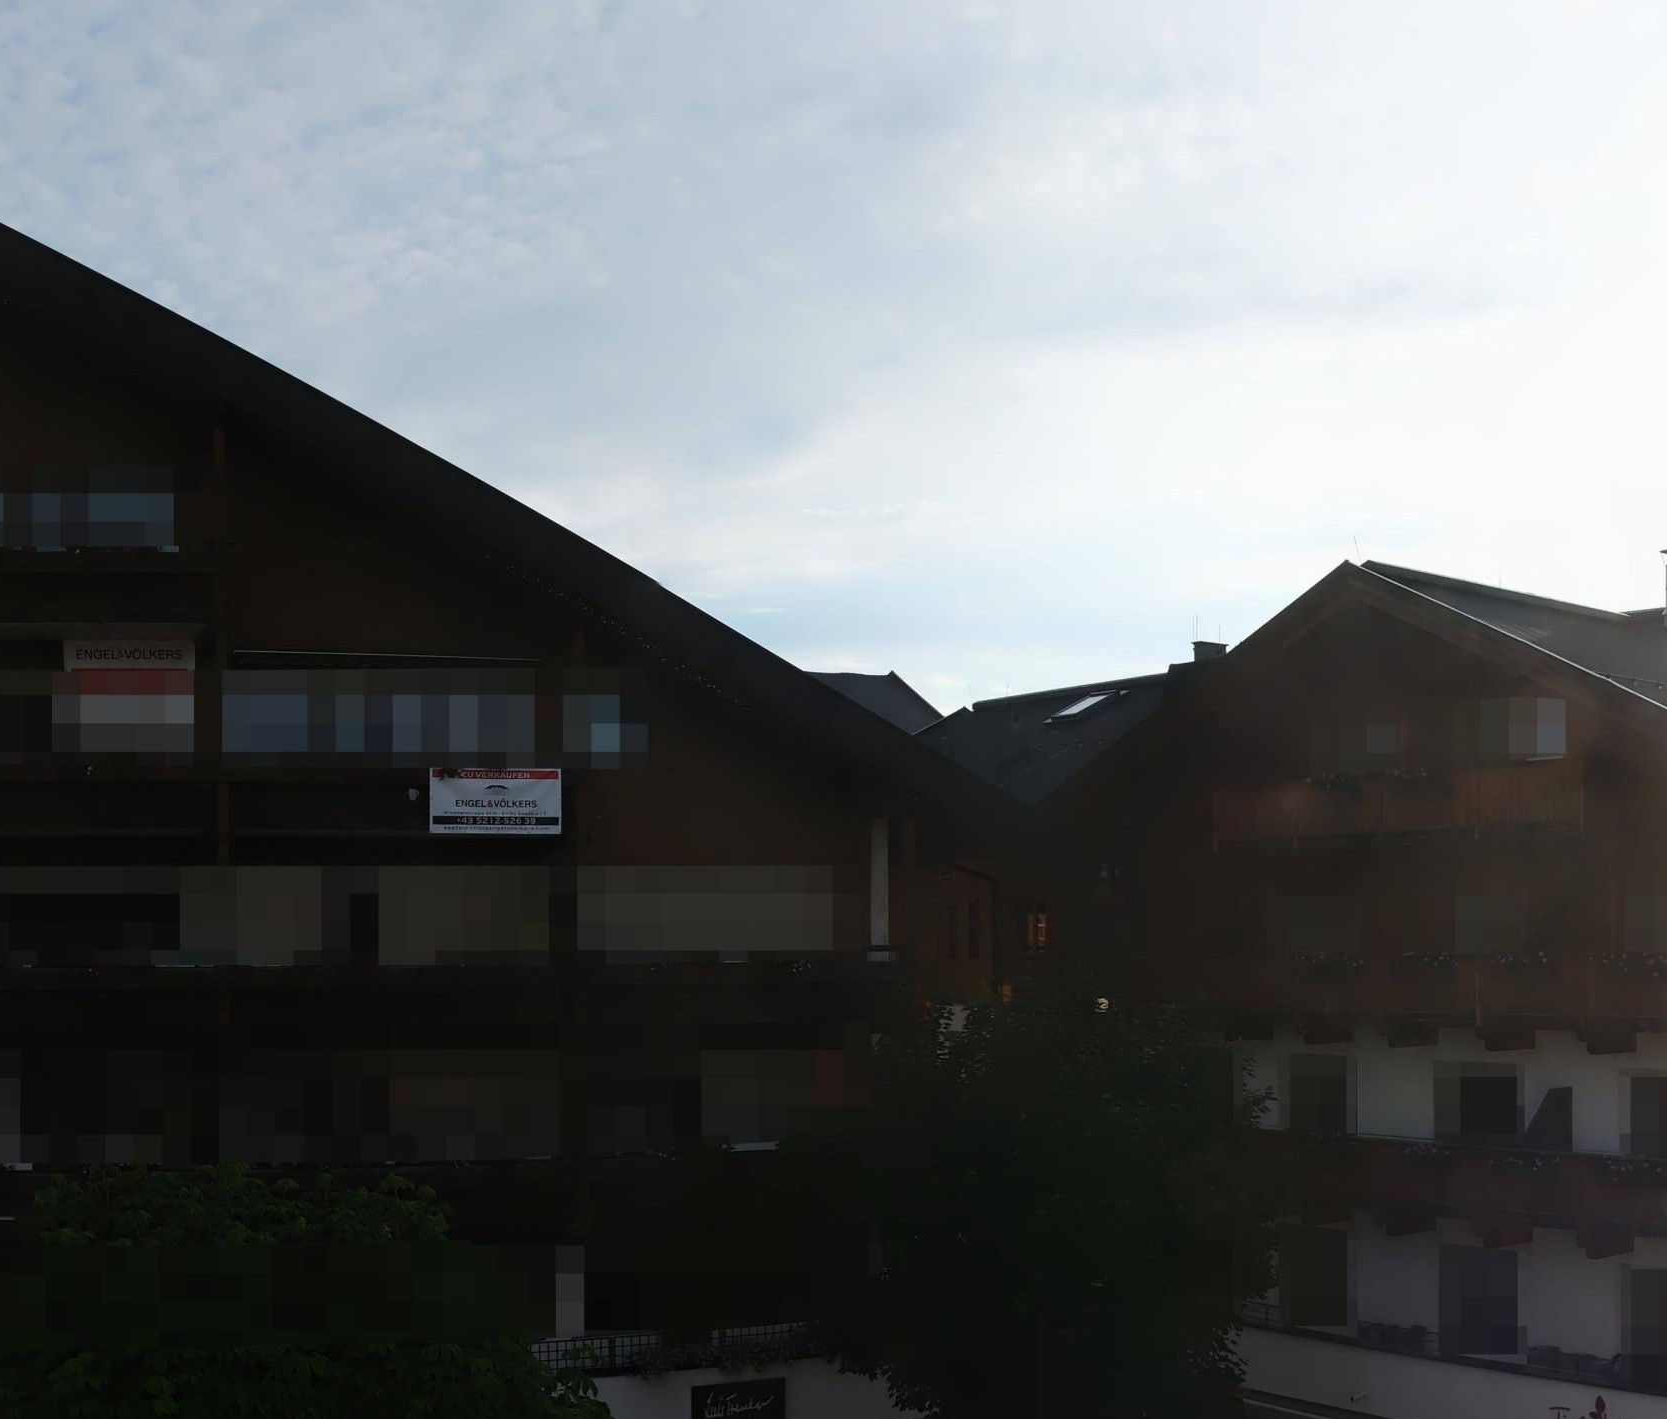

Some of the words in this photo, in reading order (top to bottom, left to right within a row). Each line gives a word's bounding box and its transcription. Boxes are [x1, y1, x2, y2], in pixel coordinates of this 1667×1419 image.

[77, 648, 183, 661] ENGEL&VÖLKERS
[475, 771, 530, 779] VERKAUFEN
[455, 798, 537, 809] ENGEL&VÖLKERS
[476, 817, 521, 825] 5212-526
[524, 817, 536, 825] 39
